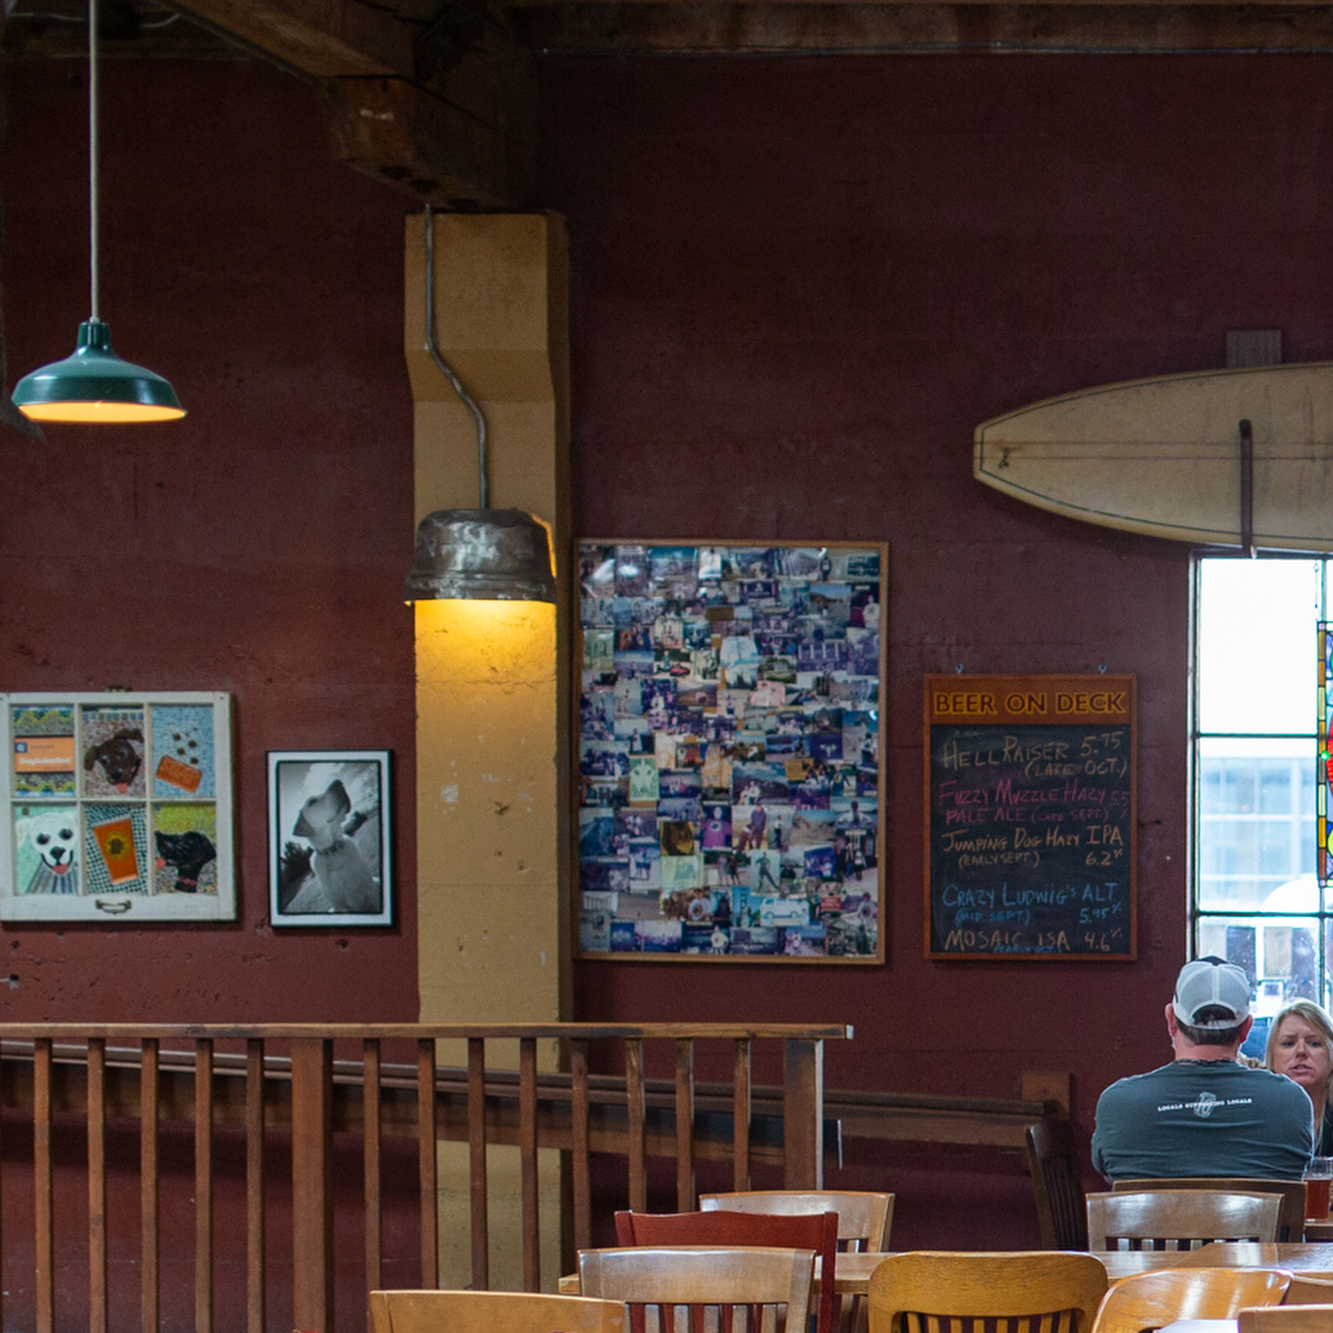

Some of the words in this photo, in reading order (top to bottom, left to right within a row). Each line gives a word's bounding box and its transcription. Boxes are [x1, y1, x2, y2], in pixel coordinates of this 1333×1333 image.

[934, 692, 997, 715] BEER
[1005, 692, 1048, 715] ON
[1055, 691, 1127, 714] DECK
[938, 779, 989, 808] FUZZY
[994, 777, 1060, 805] MUZZLE
[1063, 776, 1107, 803] HAZY
[945, 807, 990, 826] PALE
[993, 807, 1027, 822] ALE
[1013, 826, 1042, 850] DOG
[1045, 825, 1080, 847] HAZY
[1085, 824, 1124, 847] IPA
[942, 883, 995, 909] CRAZY
[1081, 882, 1118, 902] ALT
[944, 928, 1023, 952] MOSAIC
[1038, 929, 1071, 952] ISA
[1158, 1104, 1183, 1112] LOCALS
